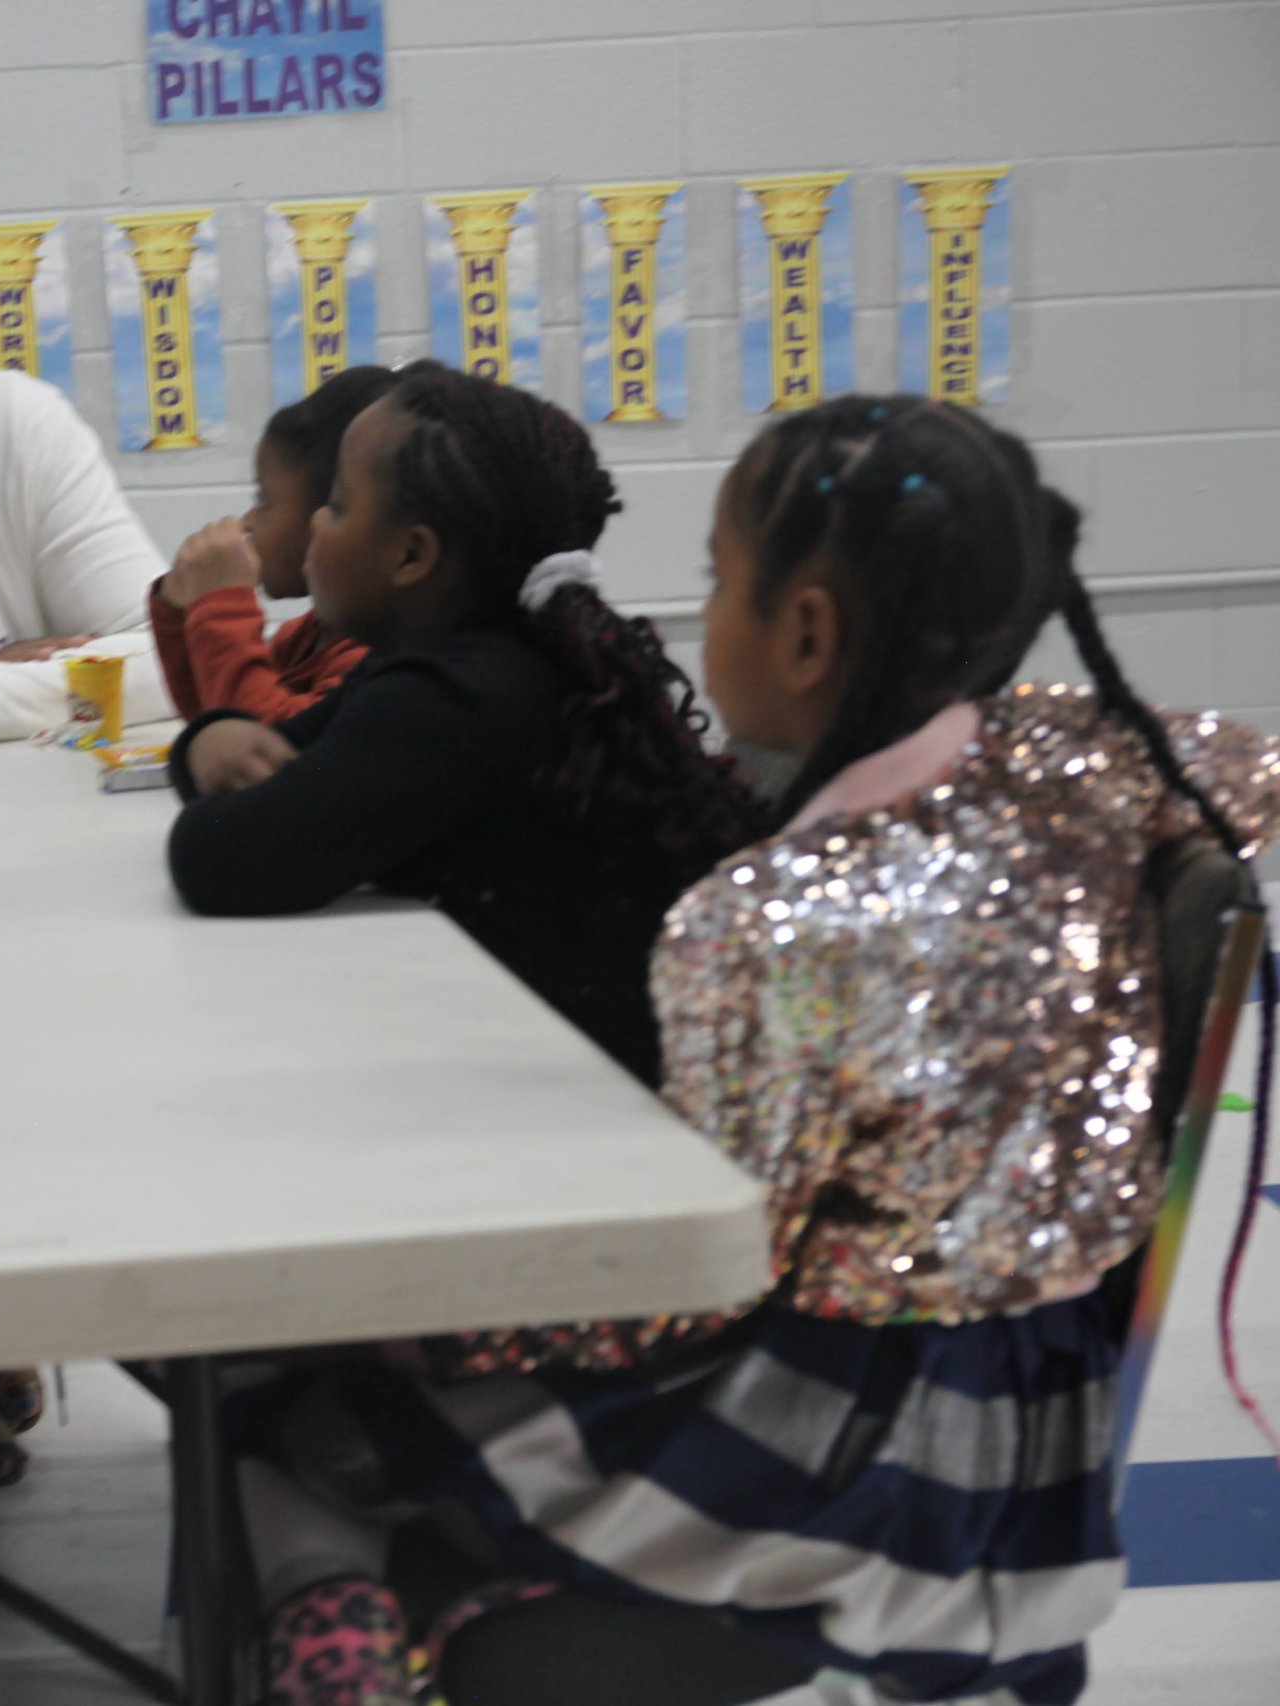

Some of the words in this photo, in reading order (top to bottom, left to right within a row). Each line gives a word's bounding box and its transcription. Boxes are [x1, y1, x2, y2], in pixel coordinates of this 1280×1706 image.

[156, 51, 382, 120] PILLARS
[166, 0, 366, 38] CHAYIL
[144, 277, 185, 435] WISDOM
[618, 249, 647, 405] FAVOR
[777, 239, 812, 396] WEALTH
[939, 233, 974, 393] INFLUENCE
